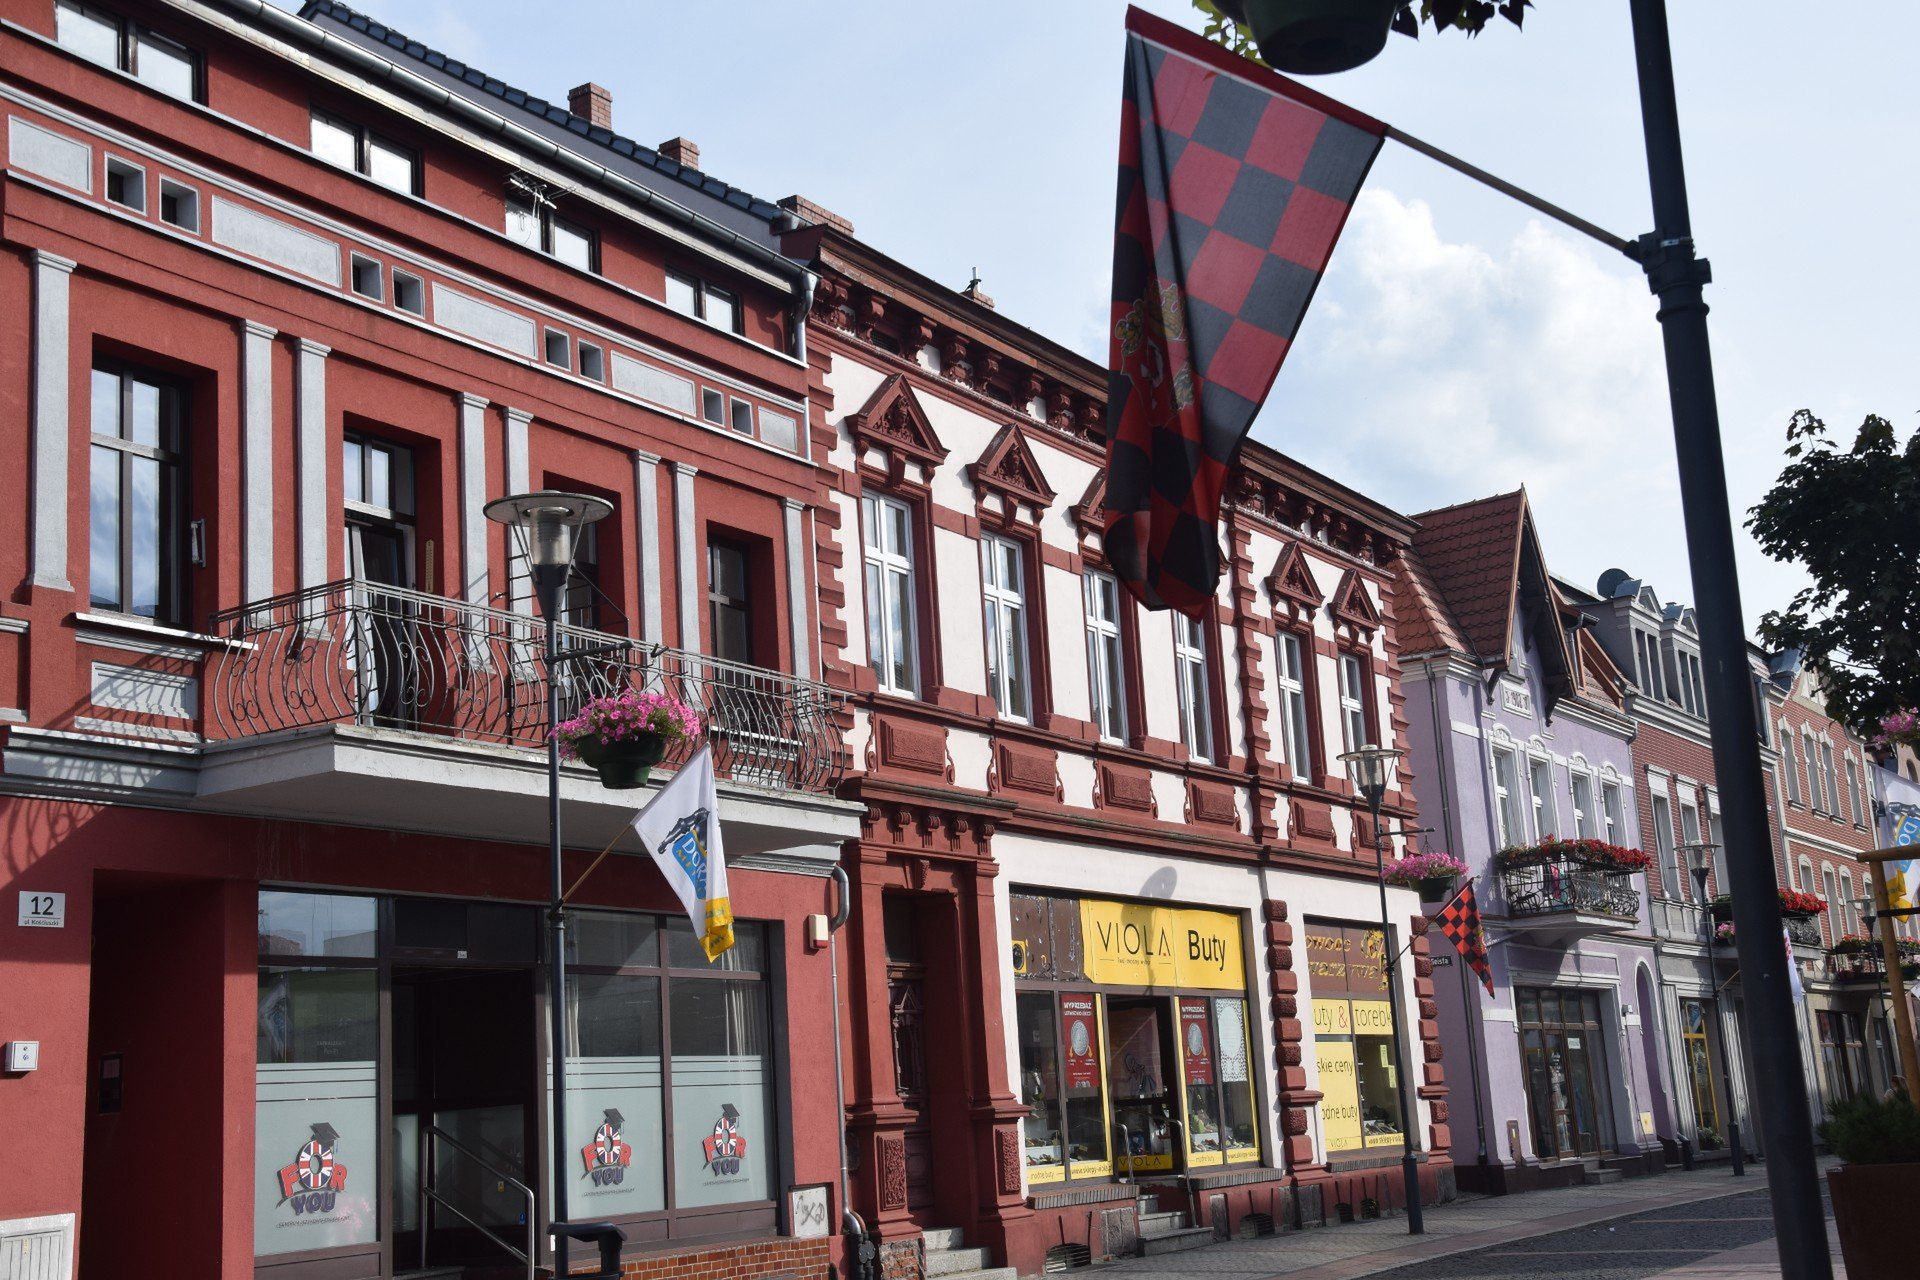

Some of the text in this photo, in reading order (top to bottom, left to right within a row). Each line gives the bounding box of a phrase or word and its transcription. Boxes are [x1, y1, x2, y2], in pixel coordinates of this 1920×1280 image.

[30, 895, 54, 916] 12
[1096, 920, 1172, 957] VIOLA
[1187, 929, 1226, 972] Buty
[1313, 1004, 1393, 1033] uty & torebk
[1316, 1058, 1354, 1077] skie ceny
[1321, 1104, 1341, 1121] odne
[581, 1123, 632, 1173] FOR
[702, 1117, 747, 1163] FOR
[277, 1139, 348, 1199] FOR
[711, 1158, 740, 1177] YOU
[1118, 1156, 1161, 1167] VOLA
[591, 1167, 624, 1188] YOU
[290, 1190, 336, 1217] YOU
